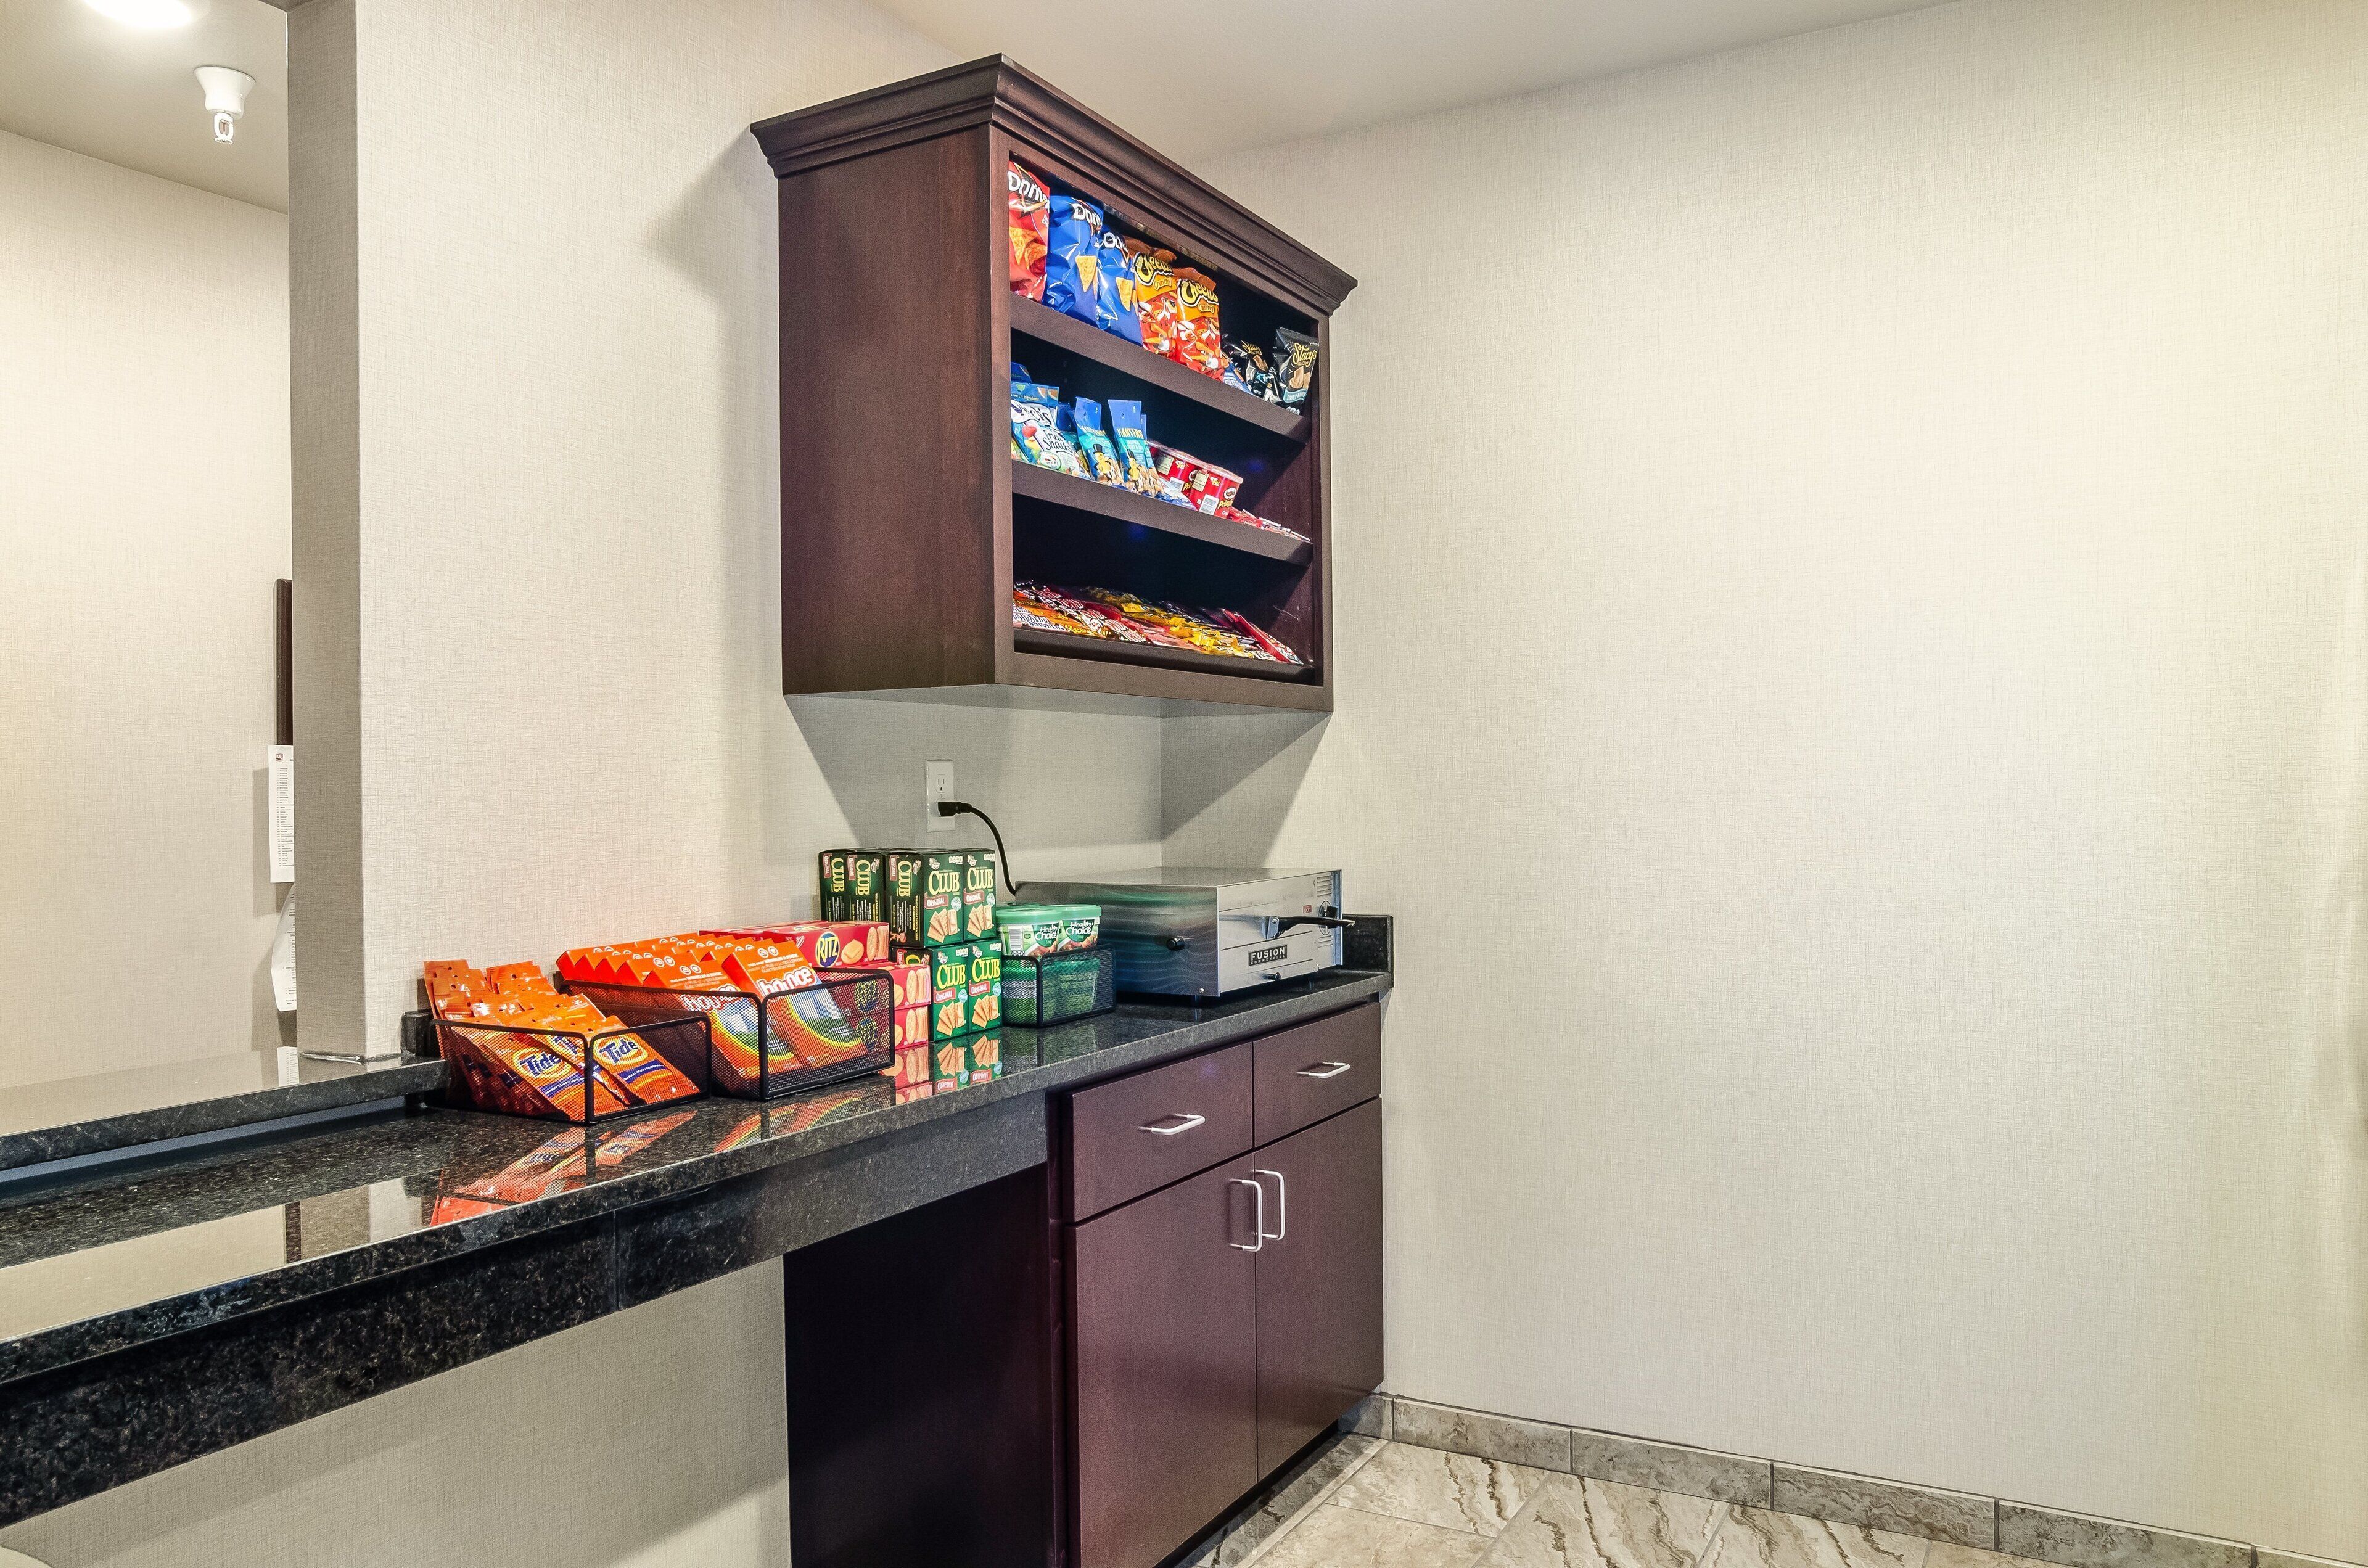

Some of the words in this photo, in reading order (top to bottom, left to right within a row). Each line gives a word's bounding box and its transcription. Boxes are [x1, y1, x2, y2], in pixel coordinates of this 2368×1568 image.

[1293, 342, 1318, 367] Stacy's
[831, 858, 844, 892] CLUB
[856, 860, 871, 895] CLUB
[898, 860, 912, 897] CLUB
[928, 870, 960, 895] CLUB
[967, 867, 993, 891] CLUB
[1035, 931, 1057, 940] Choice
[1066, 927, 1092, 935] Choice
[1070, 919, 1094, 930] Healthy
[817, 935, 839, 963] RITZ
[1251, 947, 1285, 961] FUSION
[937, 964, 966, 990] CLUB
[972, 958, 1000, 983] CLUB
[935, 990, 953, 1001] ORIGINAL
[971, 983, 987, 995] ORIGINAL
[599, 1038, 639, 1064] Tide
[519, 1052, 562, 1077] Tide
